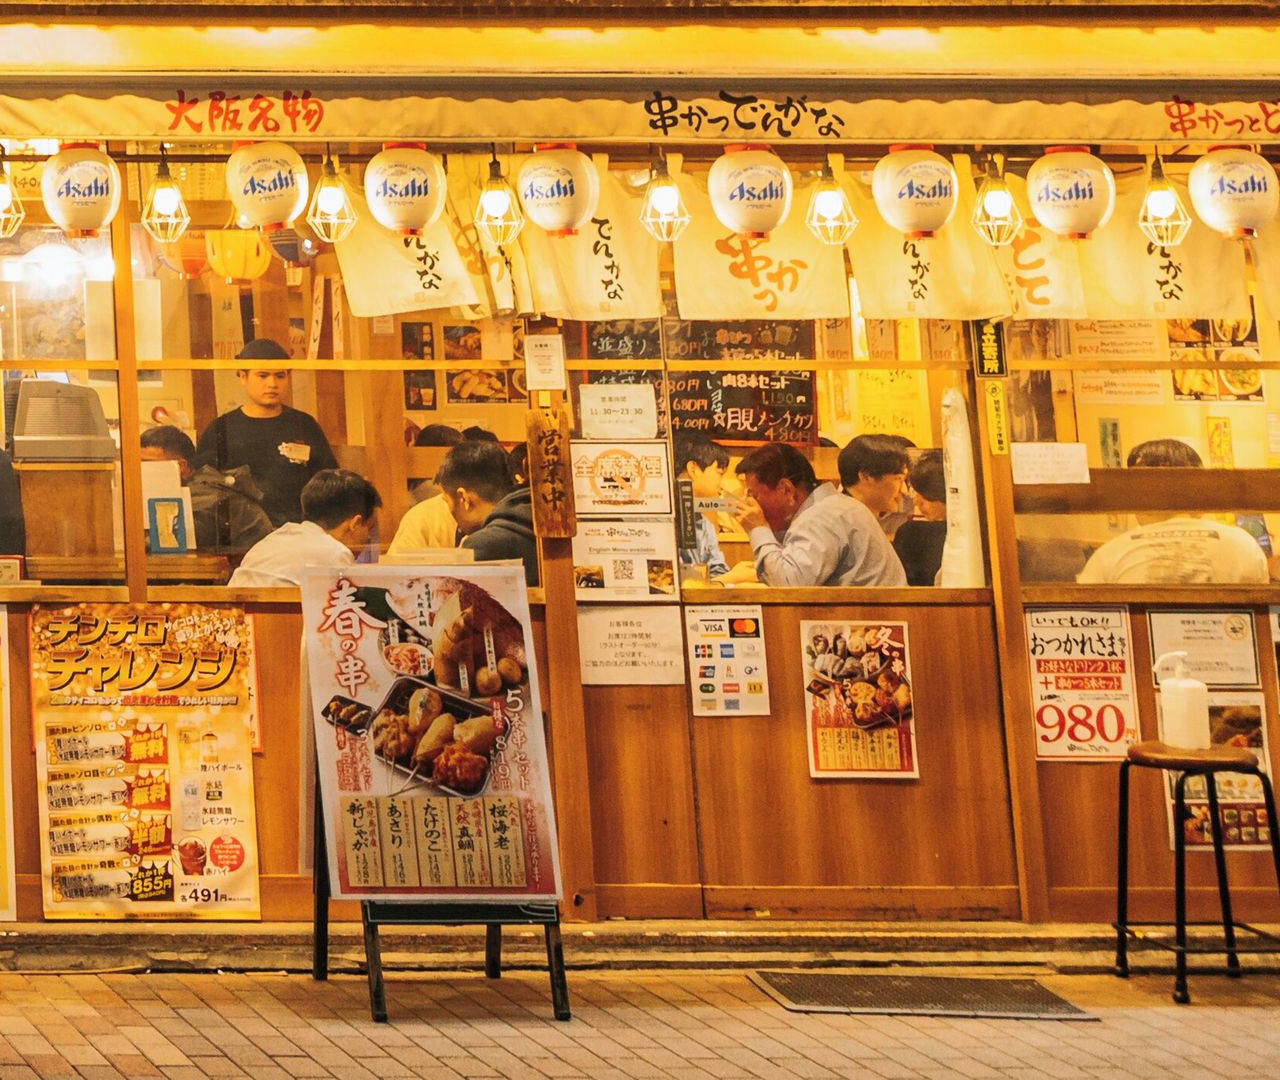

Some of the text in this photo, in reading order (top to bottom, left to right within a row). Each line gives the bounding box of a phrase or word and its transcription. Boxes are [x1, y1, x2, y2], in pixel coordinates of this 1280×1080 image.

[166, 88, 325, 135] 大阪名物
[643, 89, 846, 139] 串かつでんがな
[57, 177, 110, 198] Asahi
[242, 169, 295, 197] Asahi
[376, 177, 429, 198] Asahi
[524, 178, 575, 200] Asahi
[729, 180, 783, 201] Asahi
[897, 178, 953, 200] Asahi
[1037, 182, 1094, 202] Asahi
[1210, 174, 1268, 196] Asahi
[537, 428, 565, 512] 営業中
[48, 614, 168, 645] チンチロ
[319, 577, 388, 698] 春の串
[703, 623, 724, 633] VISA
[1030, 631, 1118, 657] おつかれさま
[48, 647, 238, 692] チャレンジ
[1036, 703, 1126, 743] 980
[505, 689, 532, 791] 5本串セット
[387, 803, 402, 849] あさり
[423, 803, 442, 852] たけのこ
[489, 803, 510, 850] 桜海老
